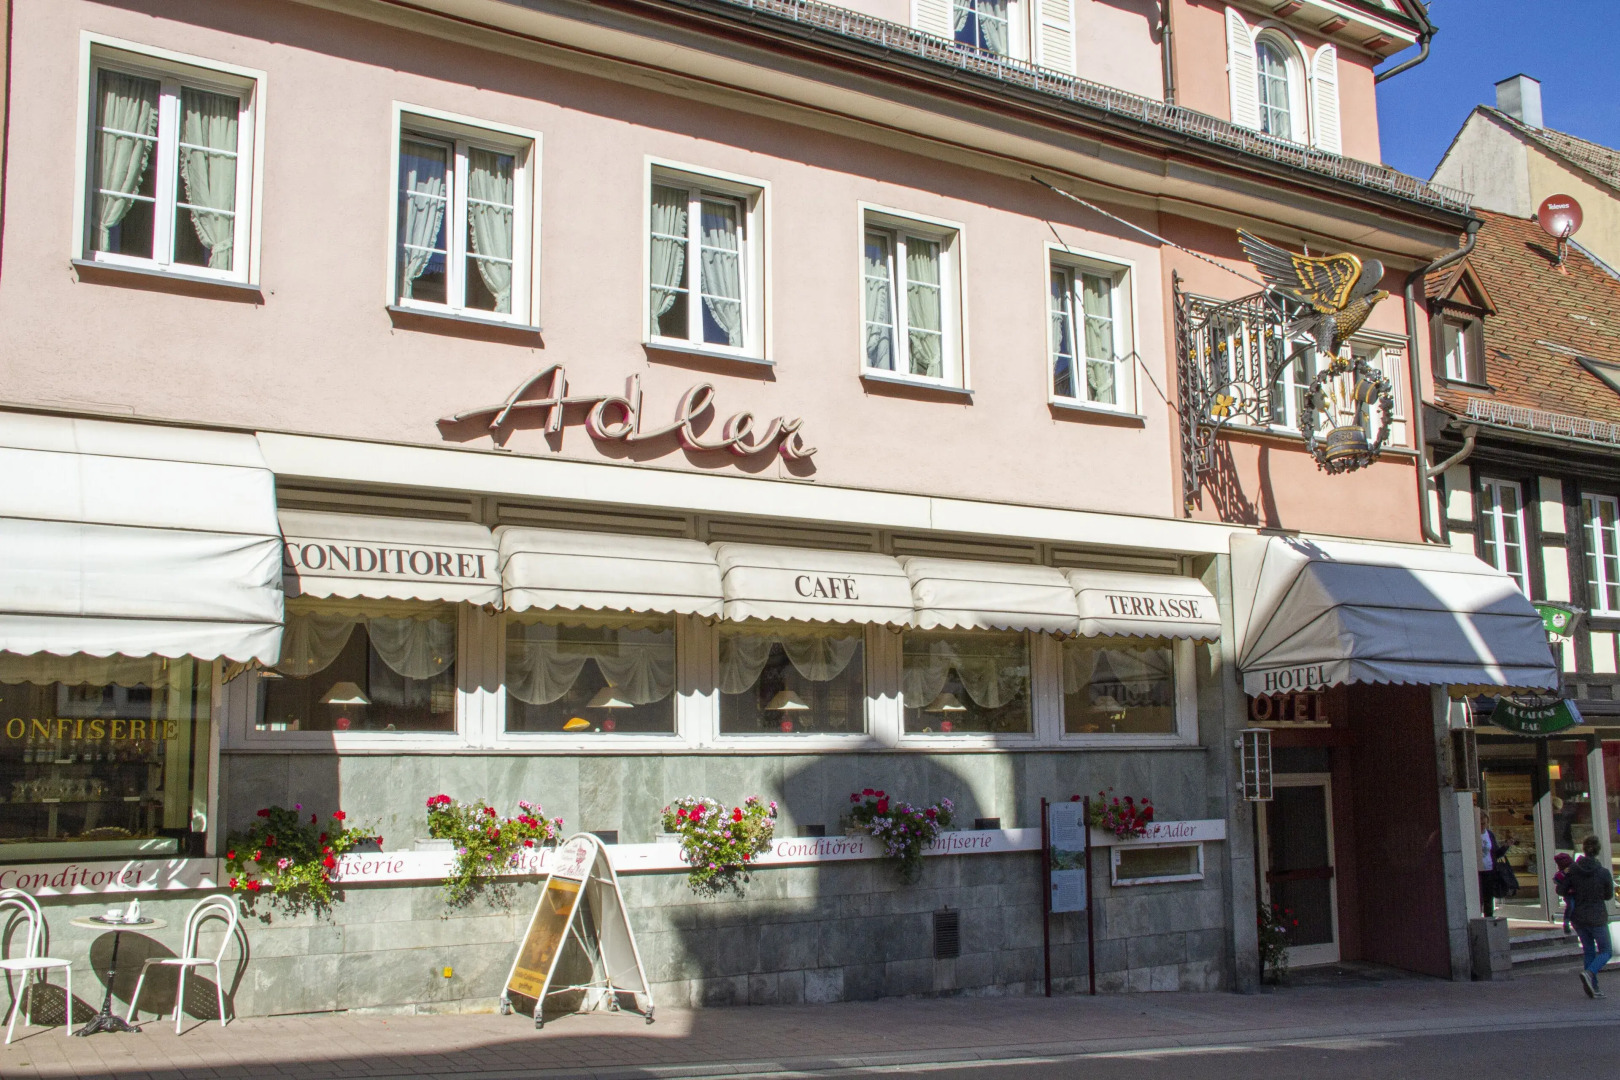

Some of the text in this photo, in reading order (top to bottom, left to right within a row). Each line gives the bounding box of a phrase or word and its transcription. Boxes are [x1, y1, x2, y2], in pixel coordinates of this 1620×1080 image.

[436, 362, 817, 459] Adler
[283, 542, 488, 580] CONDITOREI
[794, 574, 859, 600] CAFÉ
[1105, 595, 1203, 619] TERRASSE
[1263, 664, 1332, 692] HOTEL
[1252, 692, 1329, 721] OTEL
[6, 718, 178, 741] ONFISERIE
[1520, 721, 1541, 731] BAR
[0, 865, 145, 889] Conditorei
[777, 838, 865, 857] Conditorei
[1161, 821, 1198, 838] Adler
